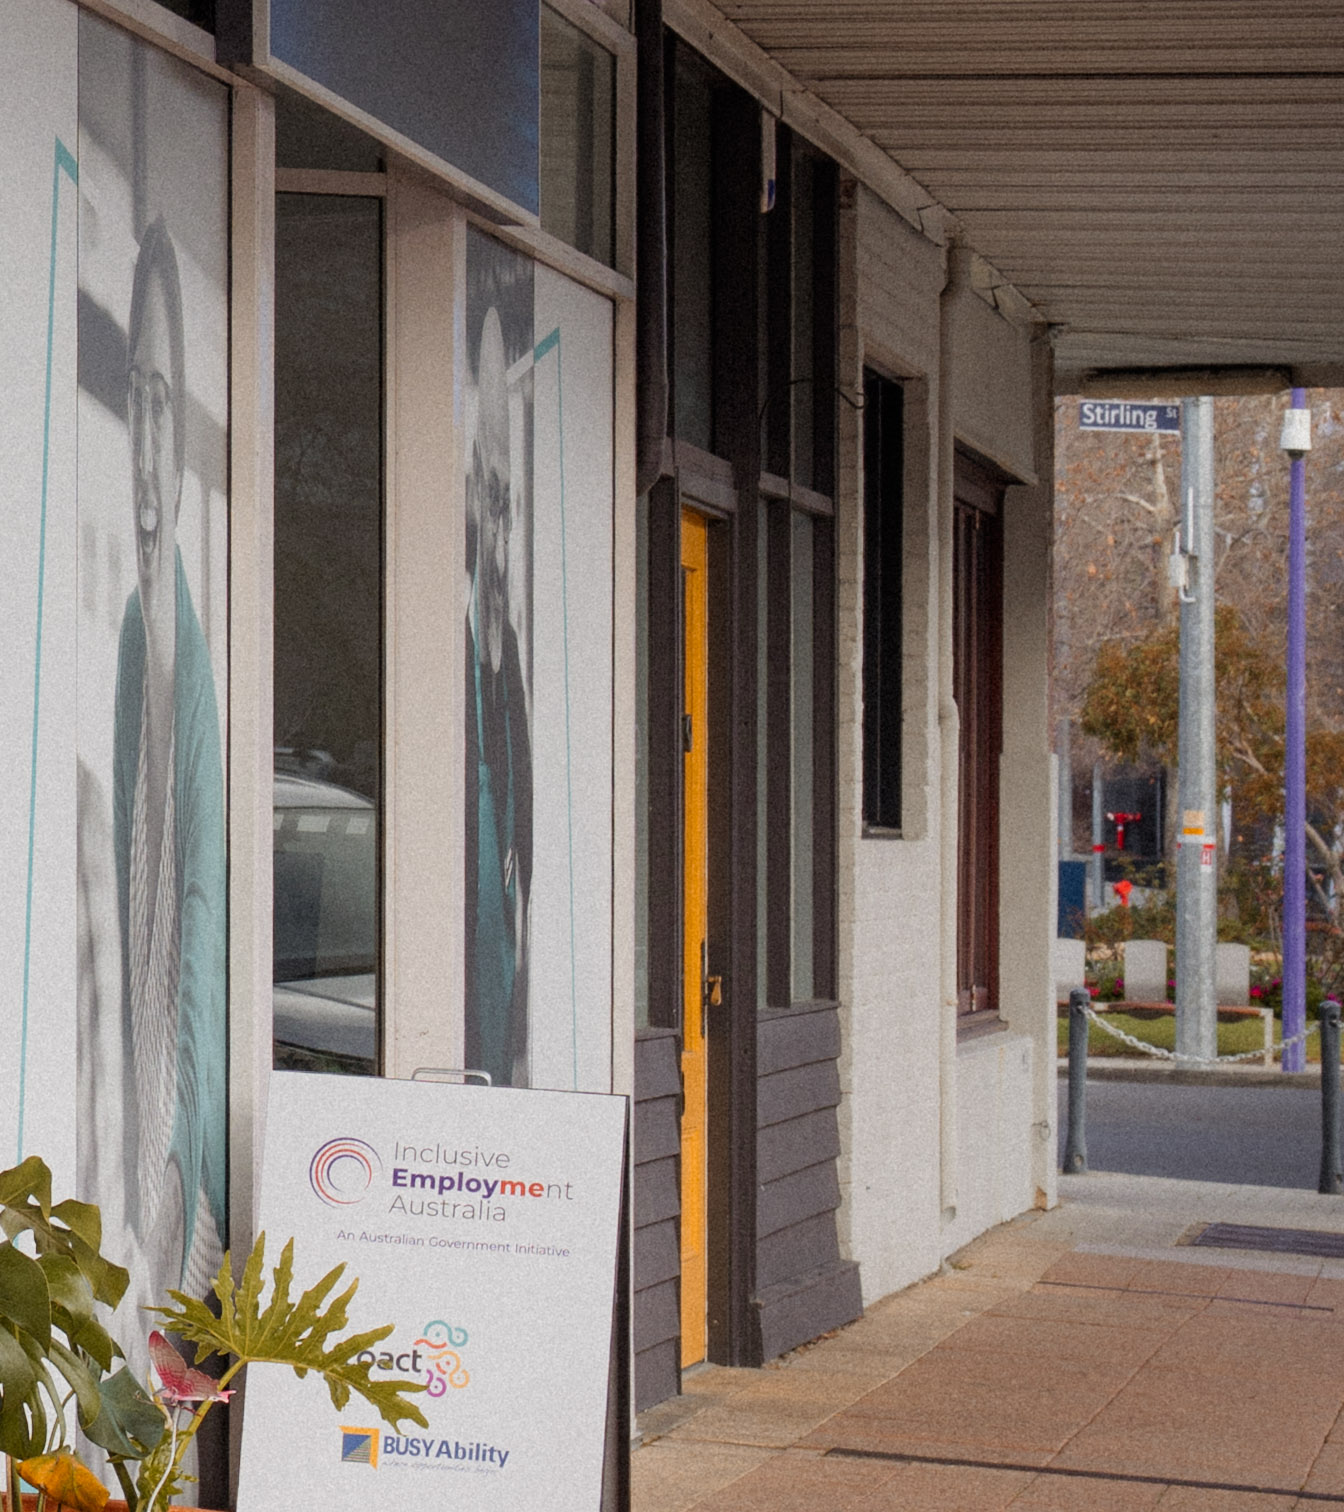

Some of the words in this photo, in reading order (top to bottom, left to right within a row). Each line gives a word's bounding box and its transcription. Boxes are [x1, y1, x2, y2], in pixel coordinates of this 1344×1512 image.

[1082, 403, 1158, 429] Stirling
[1166, 407, 1178, 418] St
[394, 1141, 511, 1169] Inclusive
[392, 1168, 574, 1201] Employment
[388, 1194, 507, 1222] Australia
[336, 1229, 355, 1241] An
[359, 1231, 425, 1247] Australian
[428, 1236, 511, 1253] Government
[515, 1243, 571, 1258] Initiative
